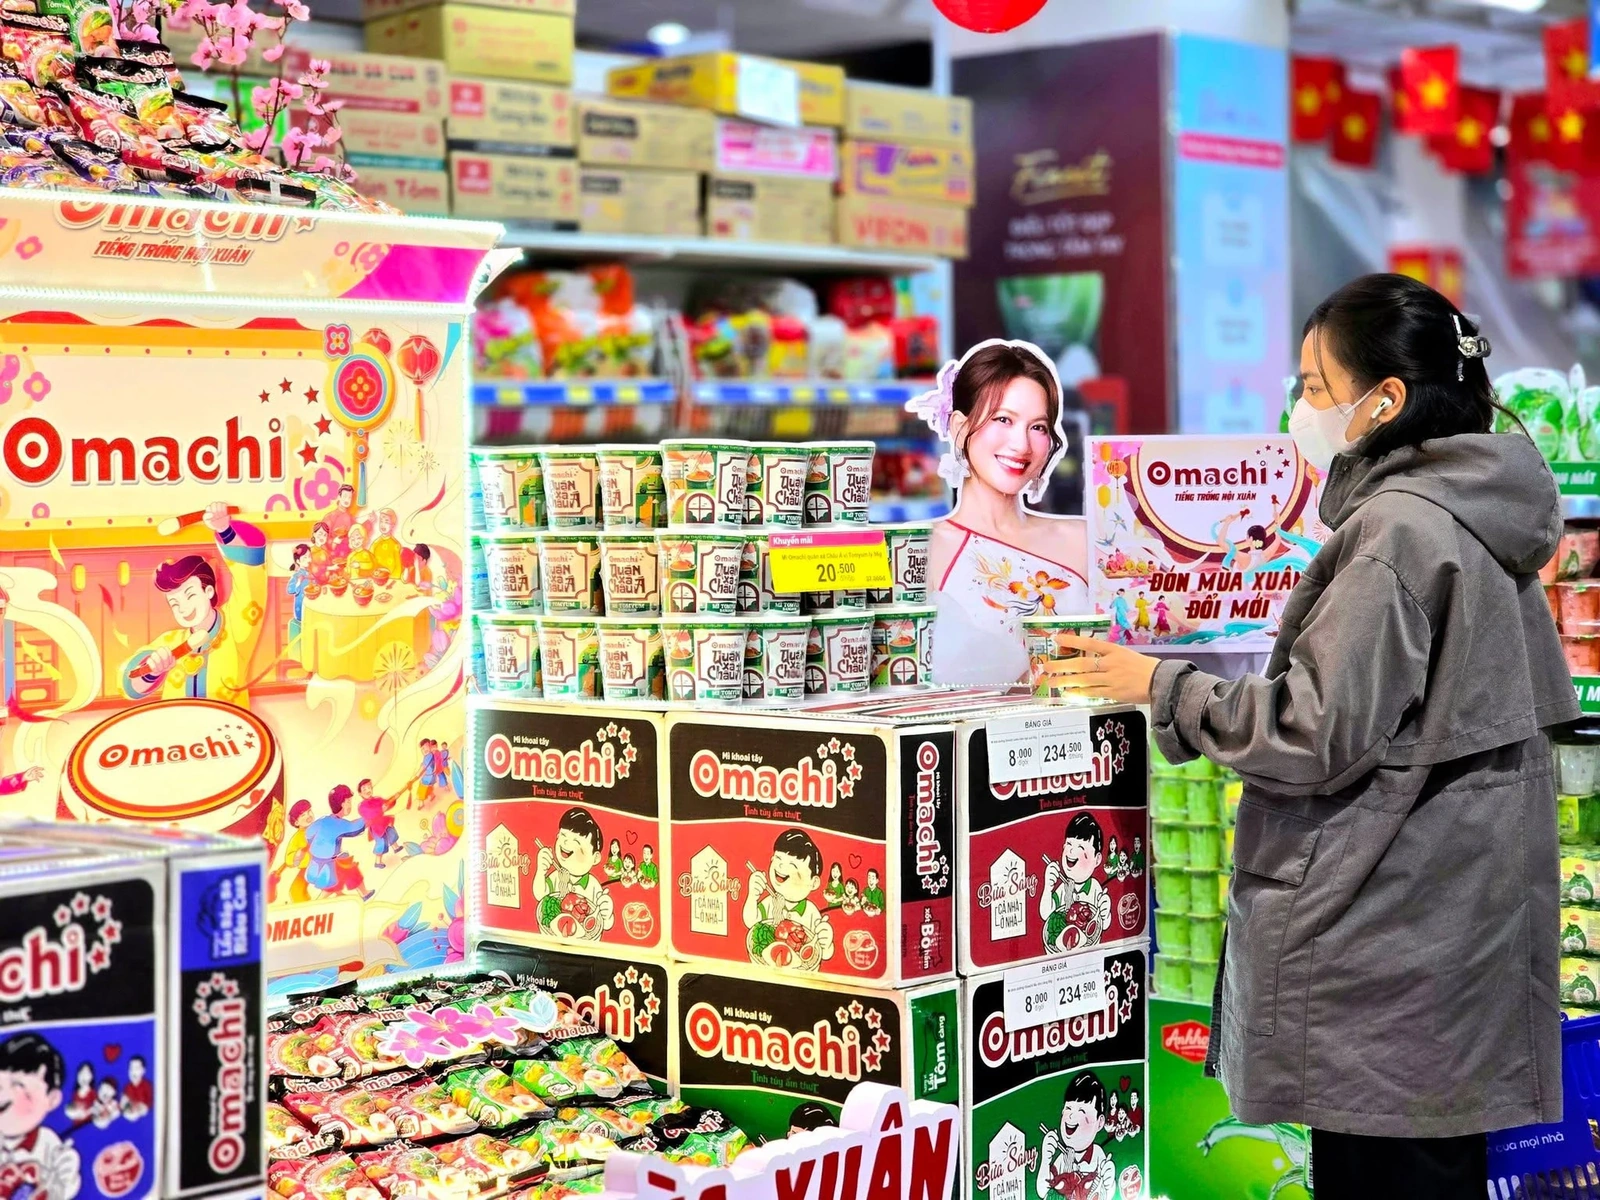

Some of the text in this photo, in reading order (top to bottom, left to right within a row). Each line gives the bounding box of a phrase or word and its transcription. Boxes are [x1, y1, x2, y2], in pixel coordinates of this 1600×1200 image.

[94, 236, 251, 264] TIẾNG TRỐNG HỘI XUÂN
[3, 415, 283, 483] Omachi
[780, 467, 804, 475] Omach
[1147, 460, 1267, 486] Omachi
[1174, 489, 1257, 503] TIẾNG TRỐNG HỘI XUÂN
[773, 535, 813, 547] Khuyến mãi
[609, 555, 639, 563] Omachi
[1148, 566, 1190, 592] ĐÓN
[1197, 567, 1242, 592] MÙA
[1185, 593, 1270, 619] ĐỔI MỚI
[1042, 717, 1053, 727] GIÁ
[98, 735, 240, 769] Omachi
[521, 736, 538, 745] khoai
[487, 736, 614, 786] Omachi
[722, 751, 763, 764] Mì khoai tây
[992, 743, 1112, 798] machi
[692, 753, 834, 804] Omachi
[917, 742, 940, 876] Omachi
[502, 847, 531, 876] Sáng
[679, 870, 742, 901] Bữa Sáng
[977, 871, 1039, 908] Bữa Sáng
[1007, 899, 1020, 913] NHÀ
[1005, 913, 1018, 928] NHÀ
[1058, 961, 1068, 970] GIÁ
[724, 1006, 773, 1024] Mì khoai tây
[689, 1007, 859, 1077] Omachi
[933, 1015, 947, 1090] Tôm càng
[210, 997, 244, 1173] Omachi
[1520, 1135, 1540, 1149] mọi
[1541, 1131, 1565, 1145] nhà
[976, 1145, 1039, 1191] Bữa Sáng
